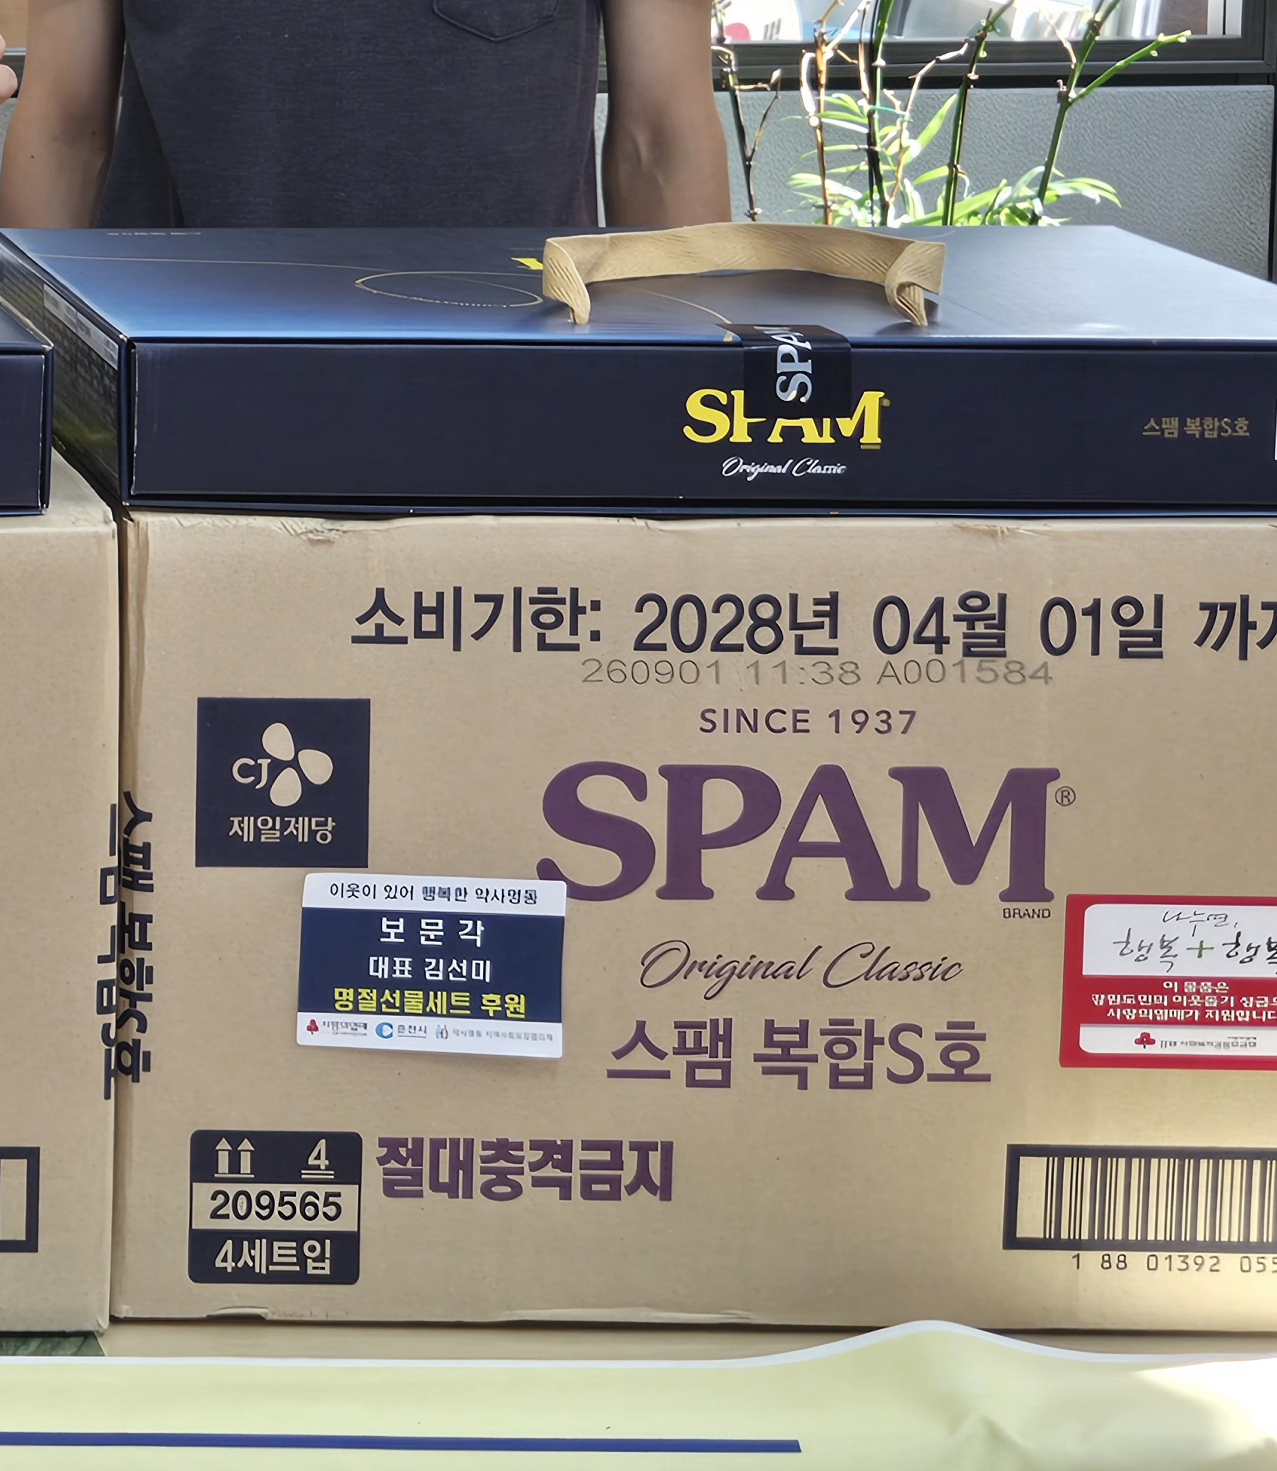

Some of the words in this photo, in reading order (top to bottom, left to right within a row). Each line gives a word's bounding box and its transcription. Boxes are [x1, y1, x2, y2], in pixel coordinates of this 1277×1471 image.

[1141, 416, 1180, 439] 스팸
[1183, 416, 1251, 439] 복합S호
[720, 456, 793, 482] Original
[791, 457, 847, 477] Classic
[350, 585, 602, 652] 소비기한:
[633, 591, 840, 658] 2028년
[871, 592, 1009, 660] 04월
[1040, 593, 1164, 659] 01일
[581, 658, 723, 686] 260901
[744, 658, 862, 686] 11:38
[875, 658, 1053, 686] A001584
[698, 708, 811, 736] SINCE
[827, 709, 918, 736] 1937
[231, 757, 272, 790] CJ
[228, 815, 336, 845] 제일제당
[535, 763, 1060, 903] SPAM
[329, 882, 377, 901] 이웃이
[383, 884, 415, 902] 있어
[421, 885, 468, 903] 행복한
[474, 886, 538, 906] 약사명동
[1002, 906, 1052, 919] BRAND
[368, 955, 413, 980] 대표
[424, 957, 492, 983] 김선미
[640, 938, 815, 1001] Original
[809, 935, 964, 987] Classic
[333, 987, 471, 1015] 명절선물세트
[480, 993, 527, 1019] 후원
[605, 1015, 733, 1090] 스팸
[751, 1015, 992, 1092] 복합S호
[307, 1140, 331, 1170] 4
[375, 1134, 674, 1203] 절대충격금지
[208, 1186, 343, 1224] 209565
[214, 1238, 333, 1276] 4세트입
[1071, 1253, 1081, 1270] 1
[1100, 1254, 1128, 1271] 88
[1146, 1254, 1222, 1273] 01392
